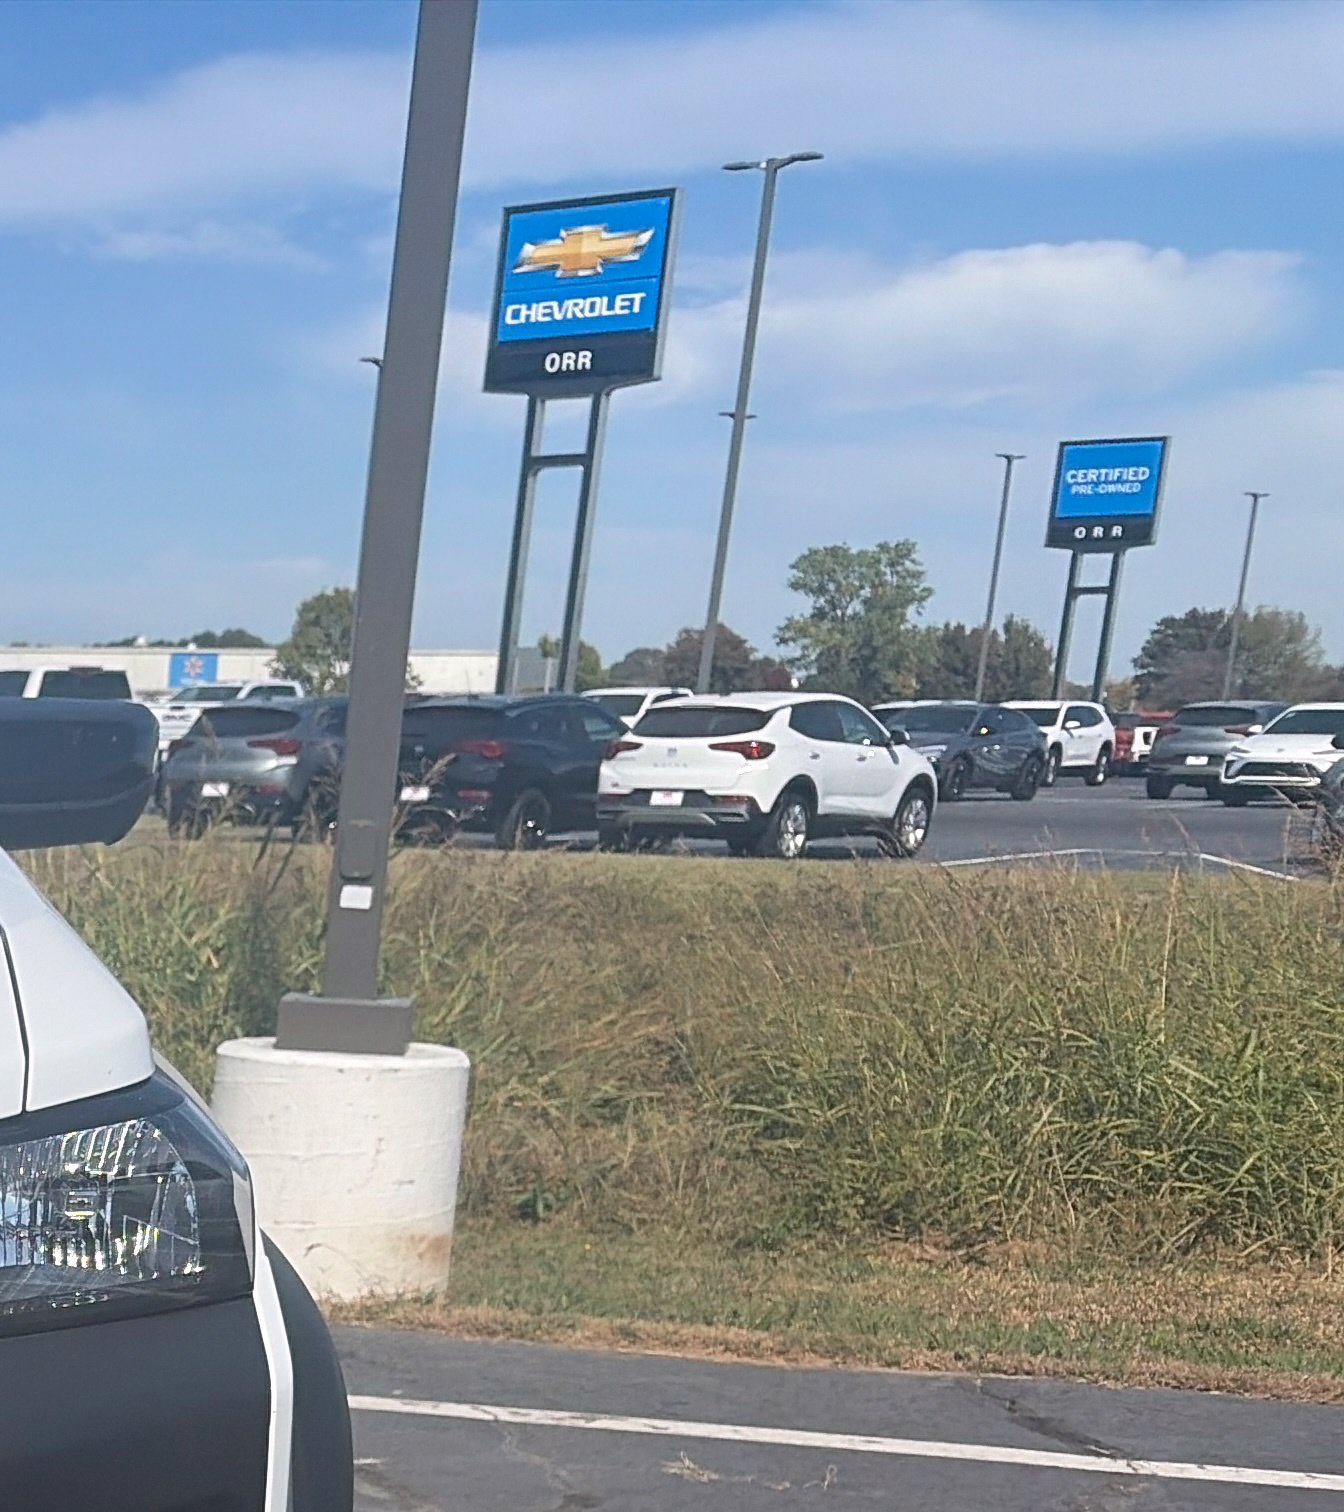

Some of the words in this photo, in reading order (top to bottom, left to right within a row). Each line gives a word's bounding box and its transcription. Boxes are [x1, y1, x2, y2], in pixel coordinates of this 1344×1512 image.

[505, 292, 647, 325] CHEVROLET
[544, 350, 593, 373] ORR
[1066, 466, 1150, 483] CERTIFIED
[1071, 482, 1142, 495] PRE-OWNED
